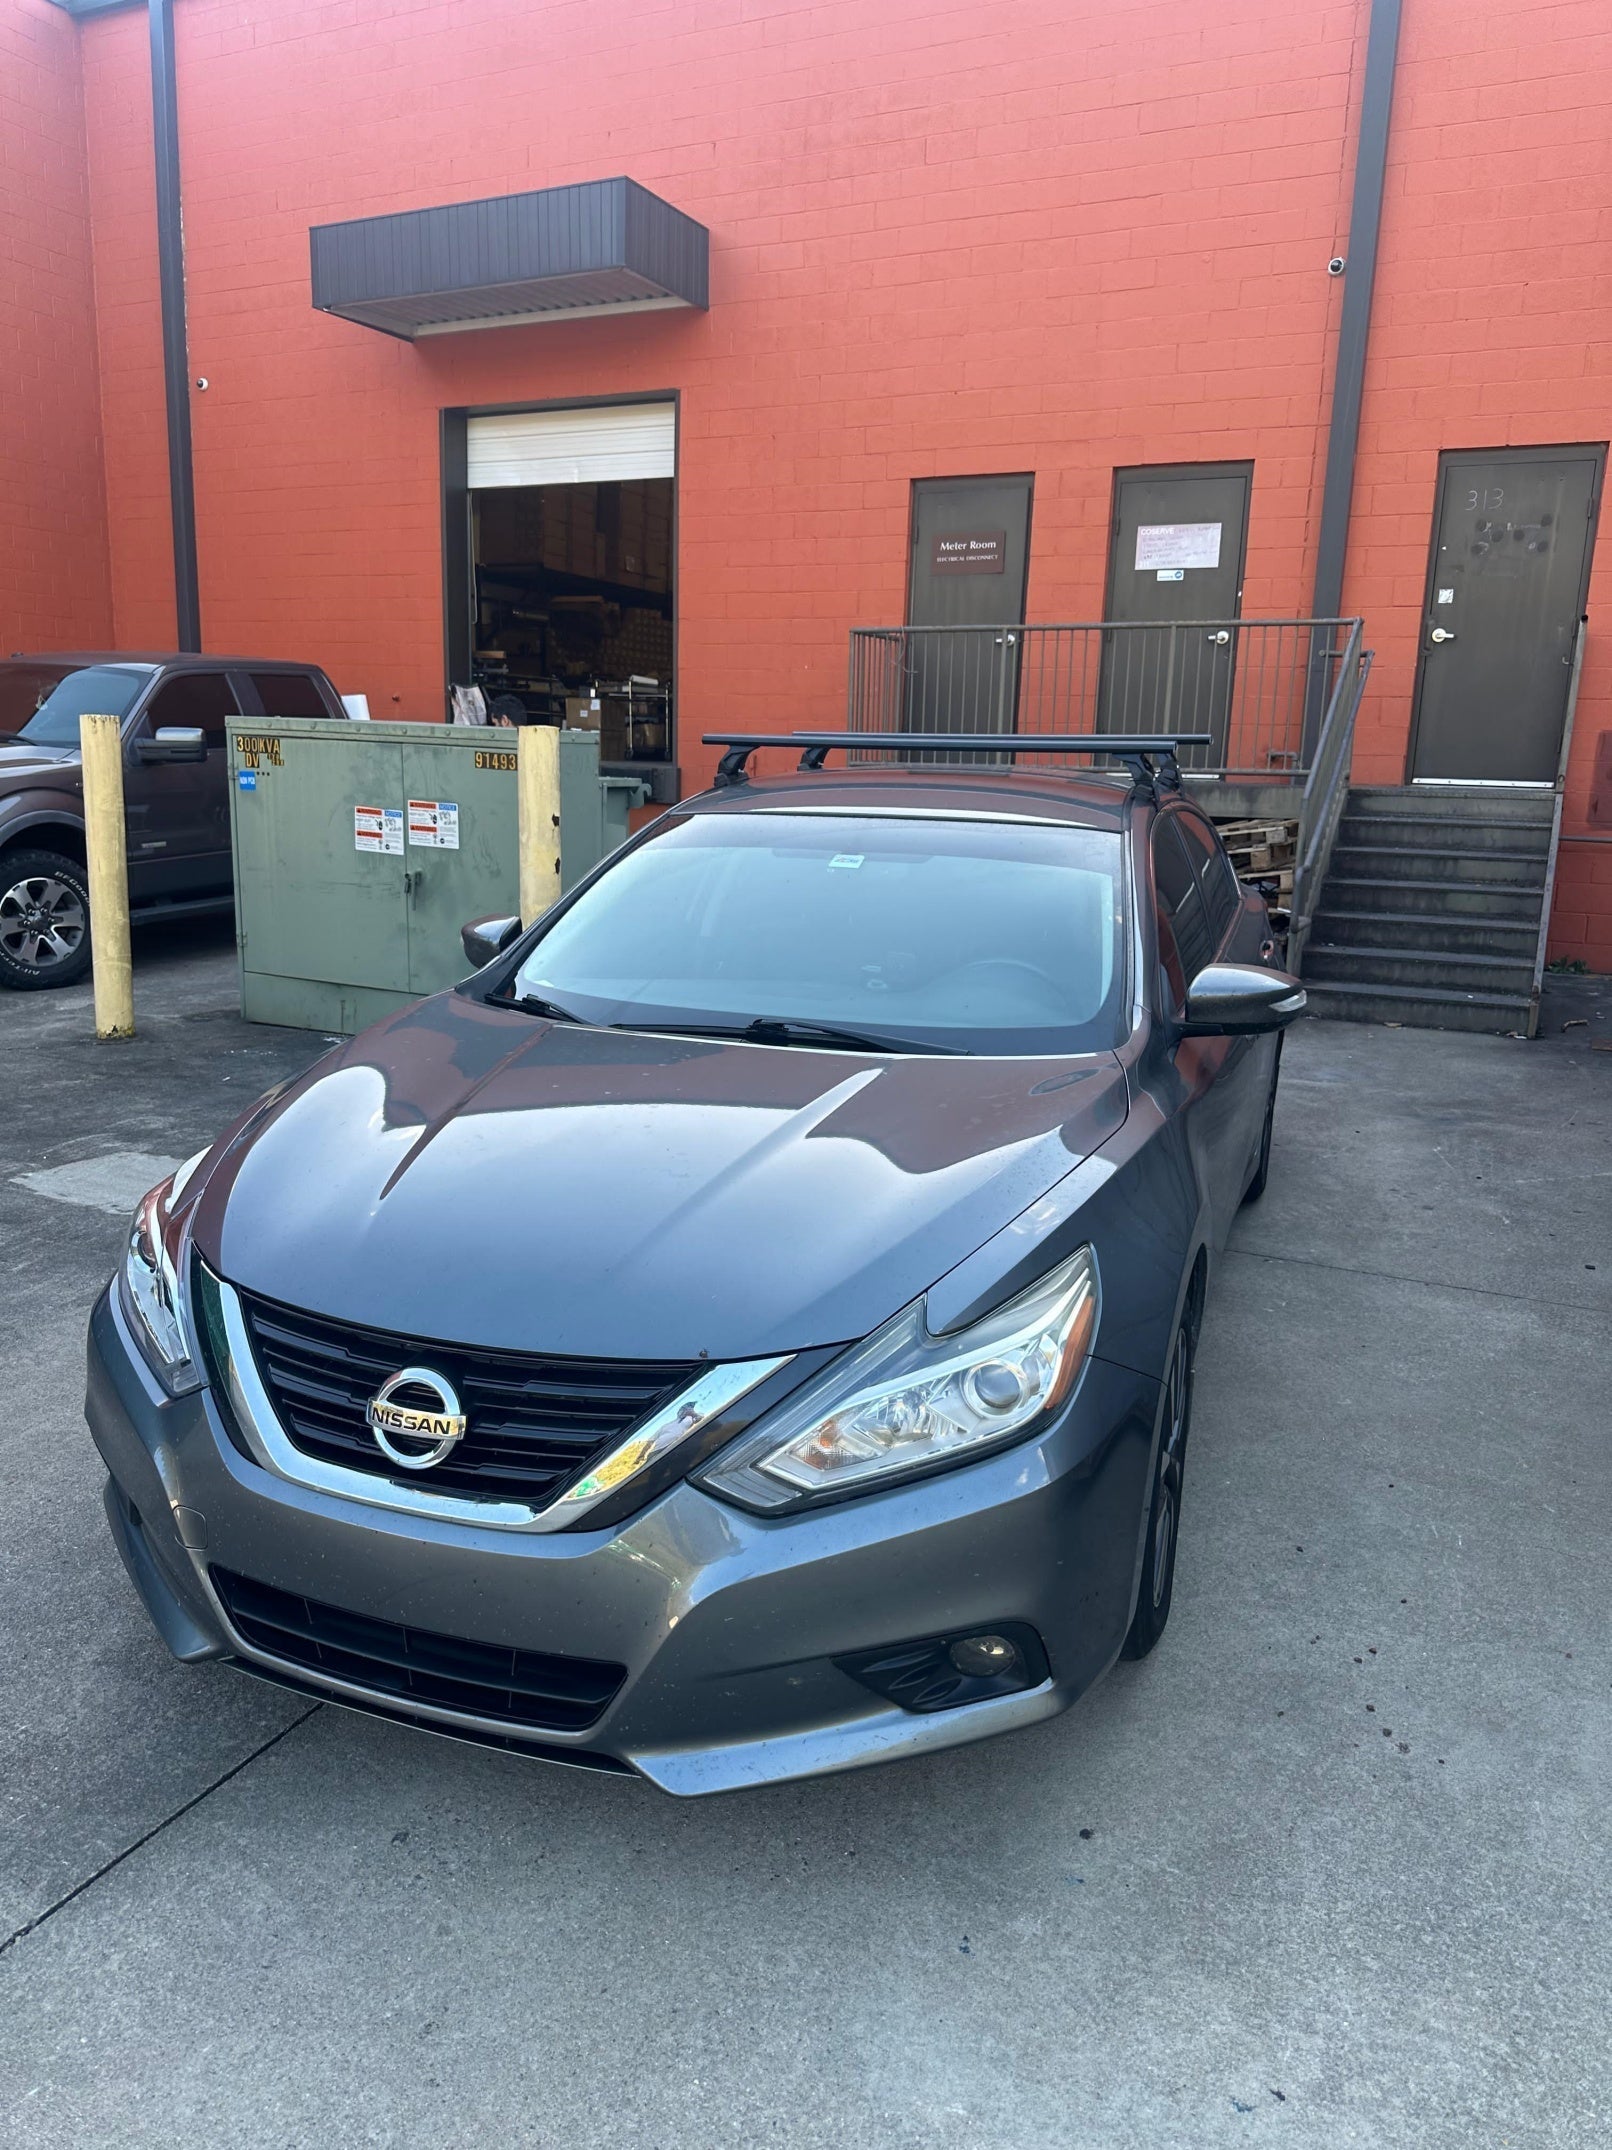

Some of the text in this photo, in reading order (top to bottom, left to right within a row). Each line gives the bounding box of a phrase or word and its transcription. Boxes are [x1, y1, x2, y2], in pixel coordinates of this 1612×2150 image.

[1465, 488, 1504, 511] 313
[940, 541, 998, 551] Meter Room
[966, 554, 998, 562] DISCONNECT
[246, 753, 260, 768] DV
[477, 752, 516, 769] 91493
[371, 1407, 451, 1435] NISSAN
